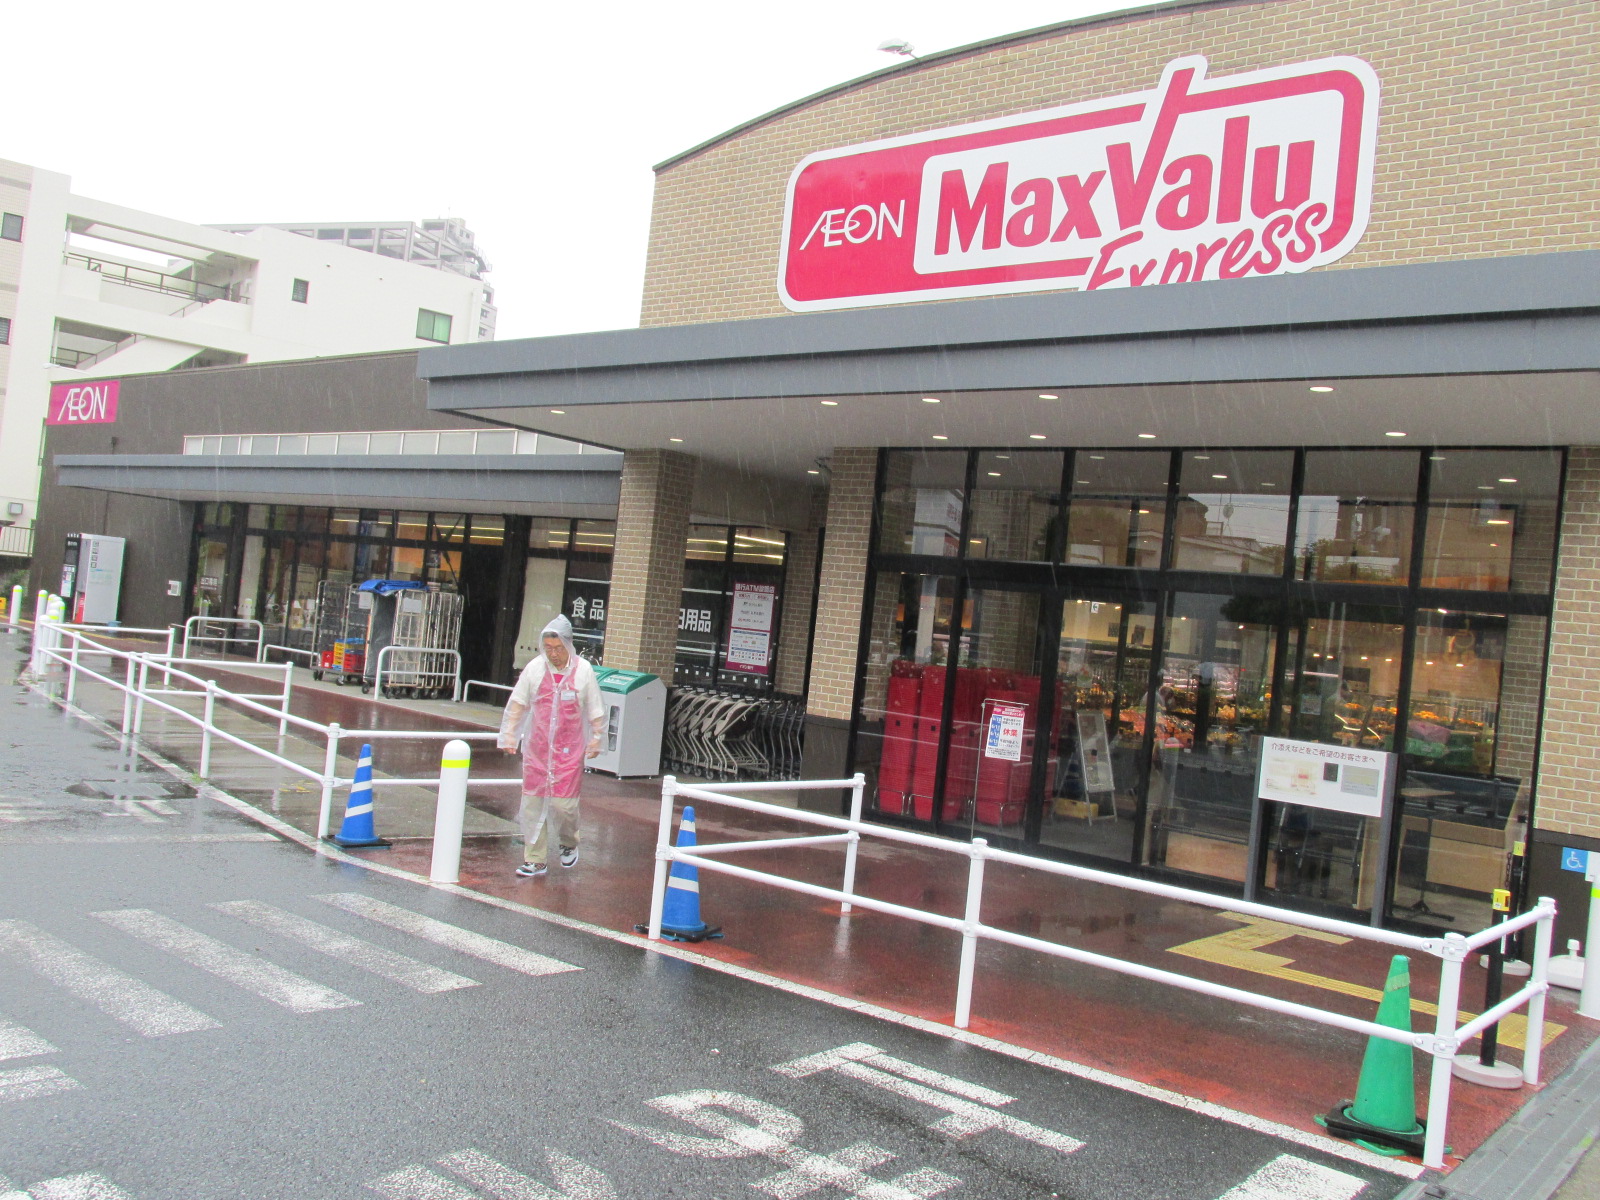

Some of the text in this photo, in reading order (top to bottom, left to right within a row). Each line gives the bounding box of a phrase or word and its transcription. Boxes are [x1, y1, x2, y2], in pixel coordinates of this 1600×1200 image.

[933, 67, 1316, 257] MaxValu
[571, 596, 605, 621] 食品
[1271, 741, 1377, 764] 介添えなどをご希望のお客さまへ
